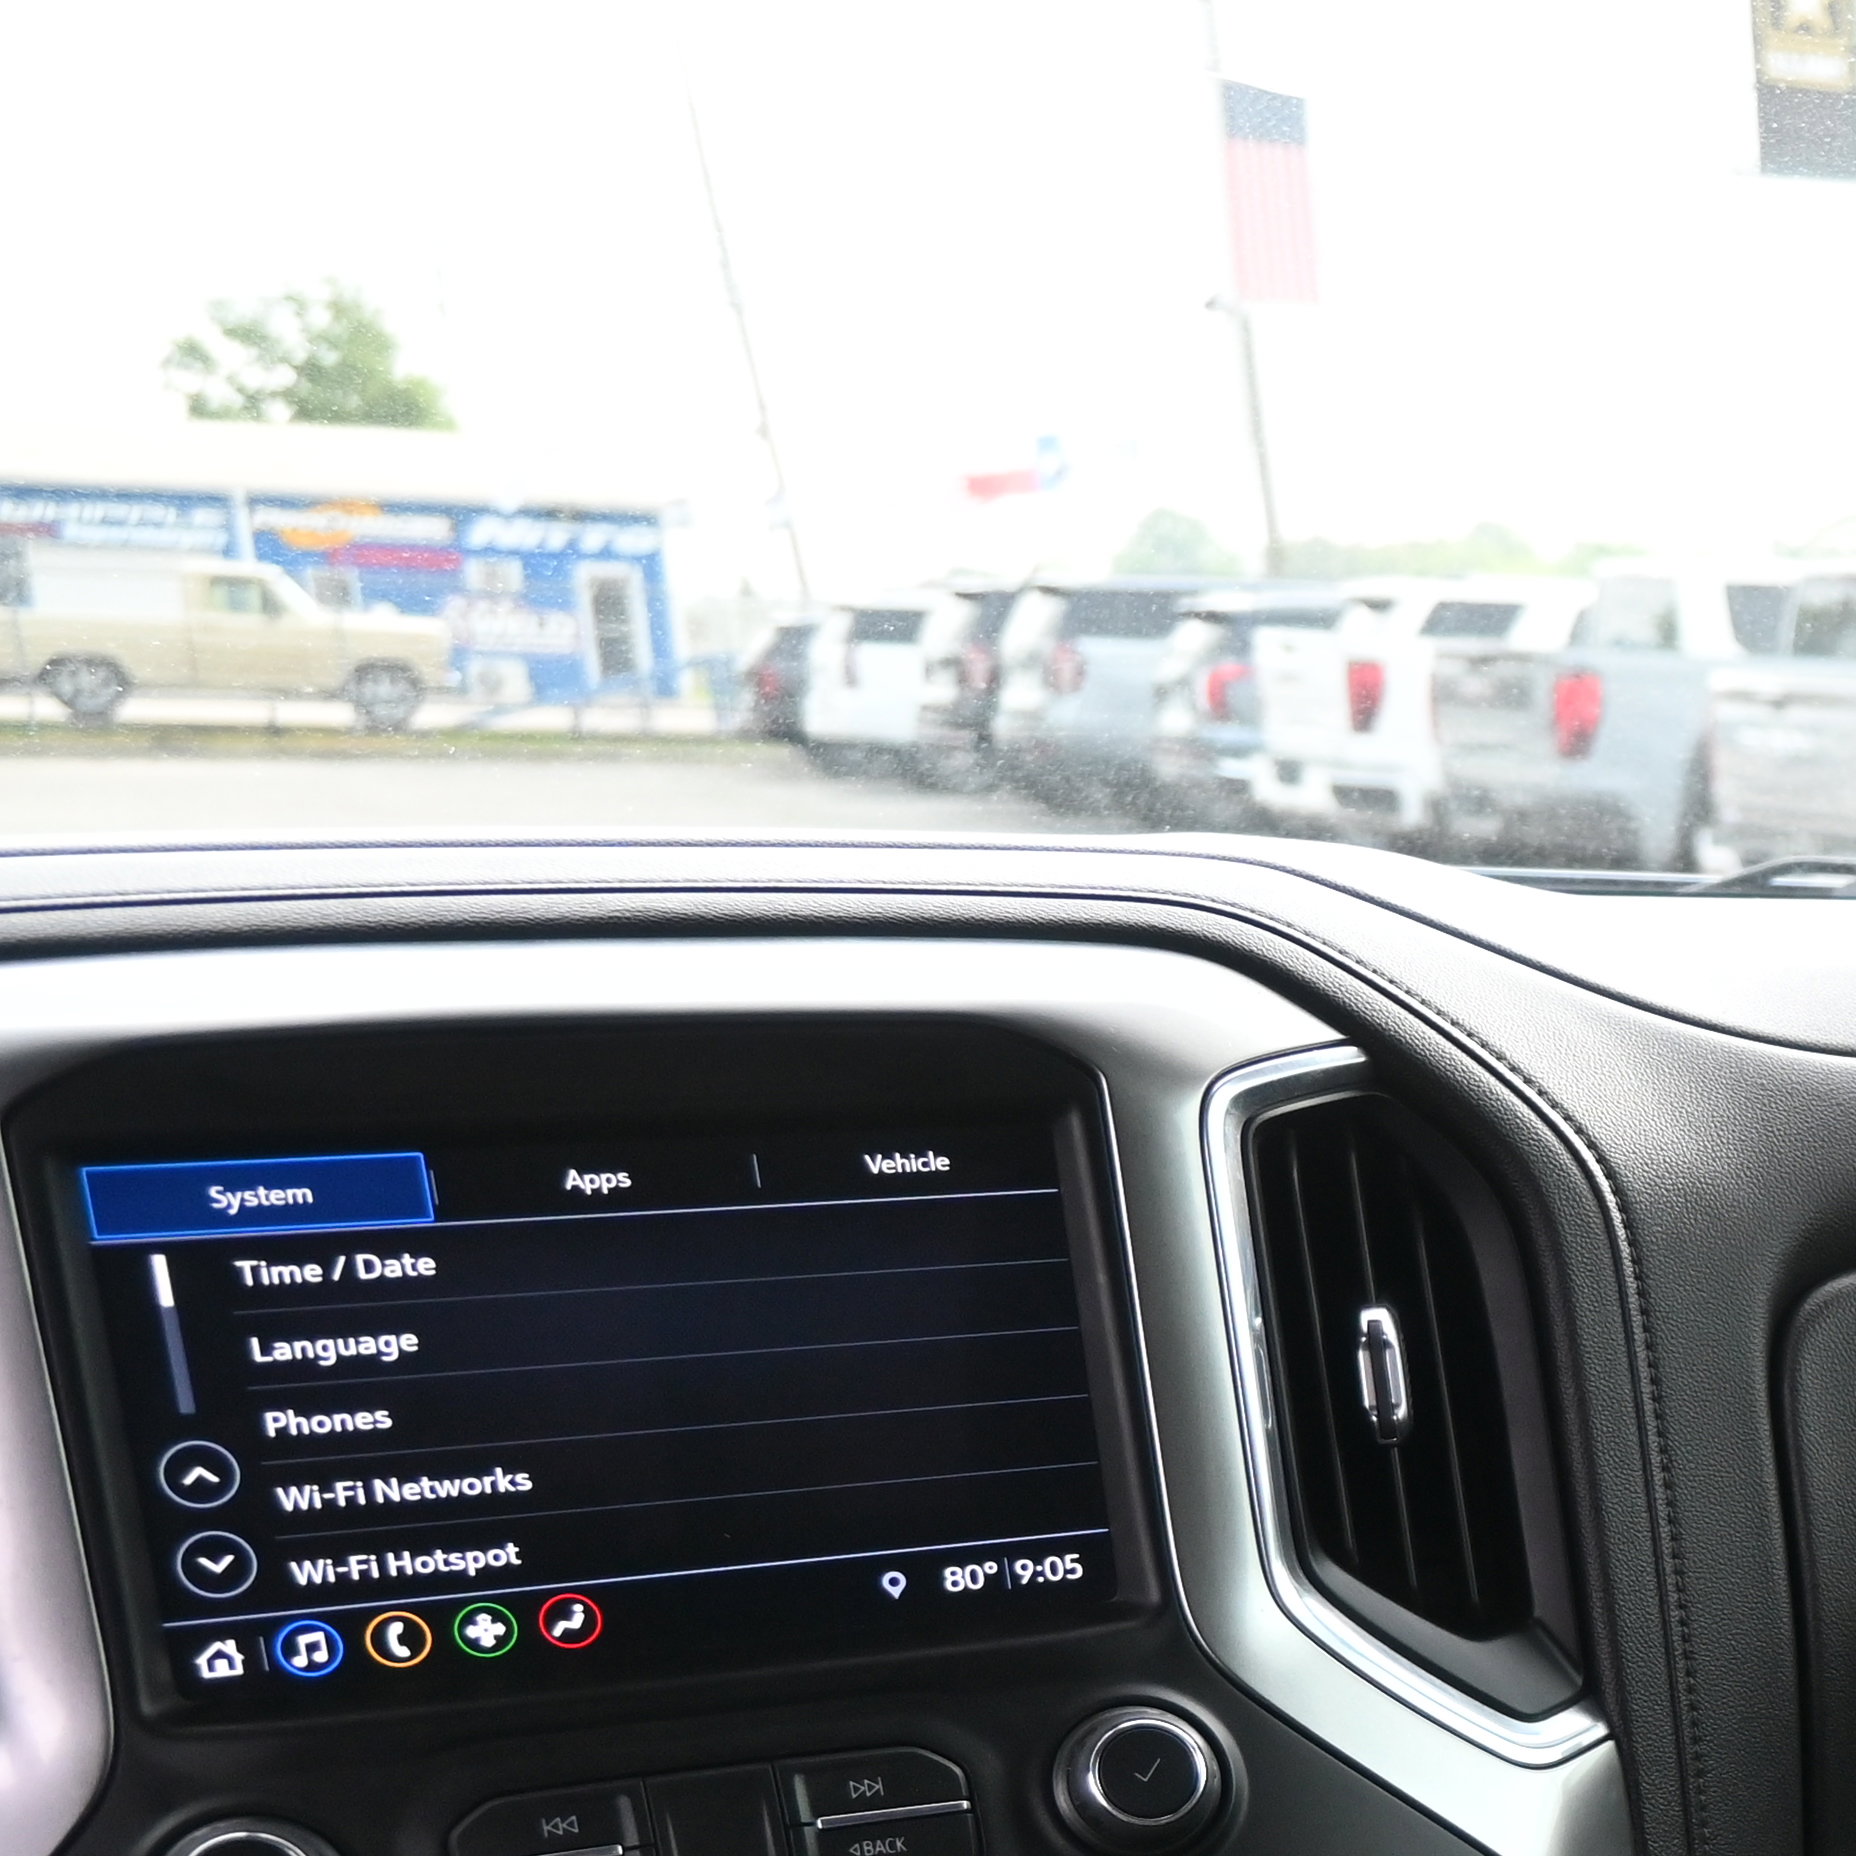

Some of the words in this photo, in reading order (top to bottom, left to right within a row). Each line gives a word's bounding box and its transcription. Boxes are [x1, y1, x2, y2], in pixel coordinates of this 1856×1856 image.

[864, 1151, 950, 1174] Vehicle
[565, 1169, 631, 1195] Apps
[210, 1187, 313, 1214] System
[233, 1260, 323, 1286] Time
[332, 1256, 346, 1281] /
[355, 1253, 436, 1280] Date
[250, 1334, 418, 1366] Language
[263, 1409, 392, 1437] Phones
[275, 1481, 366, 1512] Wi-Fi
[372, 1467, 532, 1503] Networks
[289, 1555, 379, 1585] Wi-Fi
[386, 1543, 521, 1576] Hotspot
[944, 1561, 998, 1592] 80°
[1013, 1554, 1083, 1584] 9:05
[863, 1838, 906, 1856] BACK
